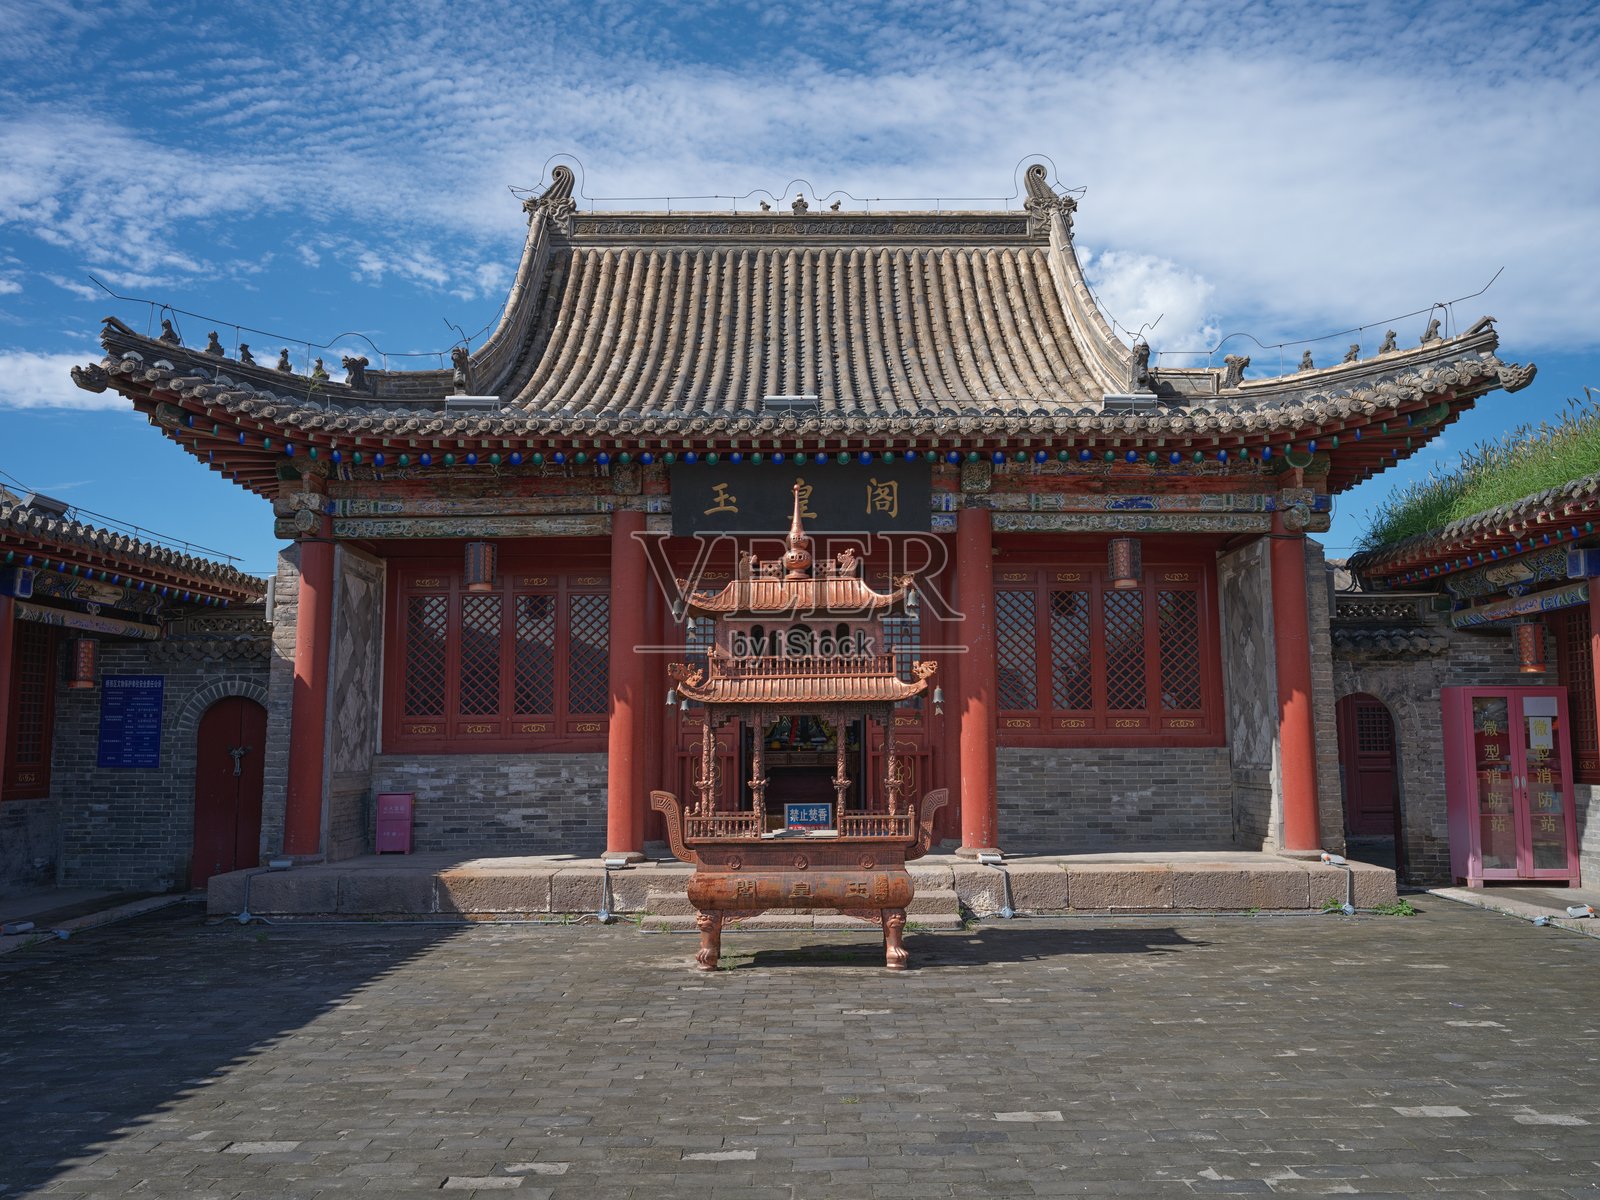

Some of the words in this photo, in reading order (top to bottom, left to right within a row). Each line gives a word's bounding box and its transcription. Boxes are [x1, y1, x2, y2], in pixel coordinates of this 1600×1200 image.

[704, 477, 898, 519] 玉皇阁
[1483, 720, 1506, 832] 微型消防站
[1532, 719, 1556, 832] 微型消防站
[790, 808, 827, 822] 禁止焚香
